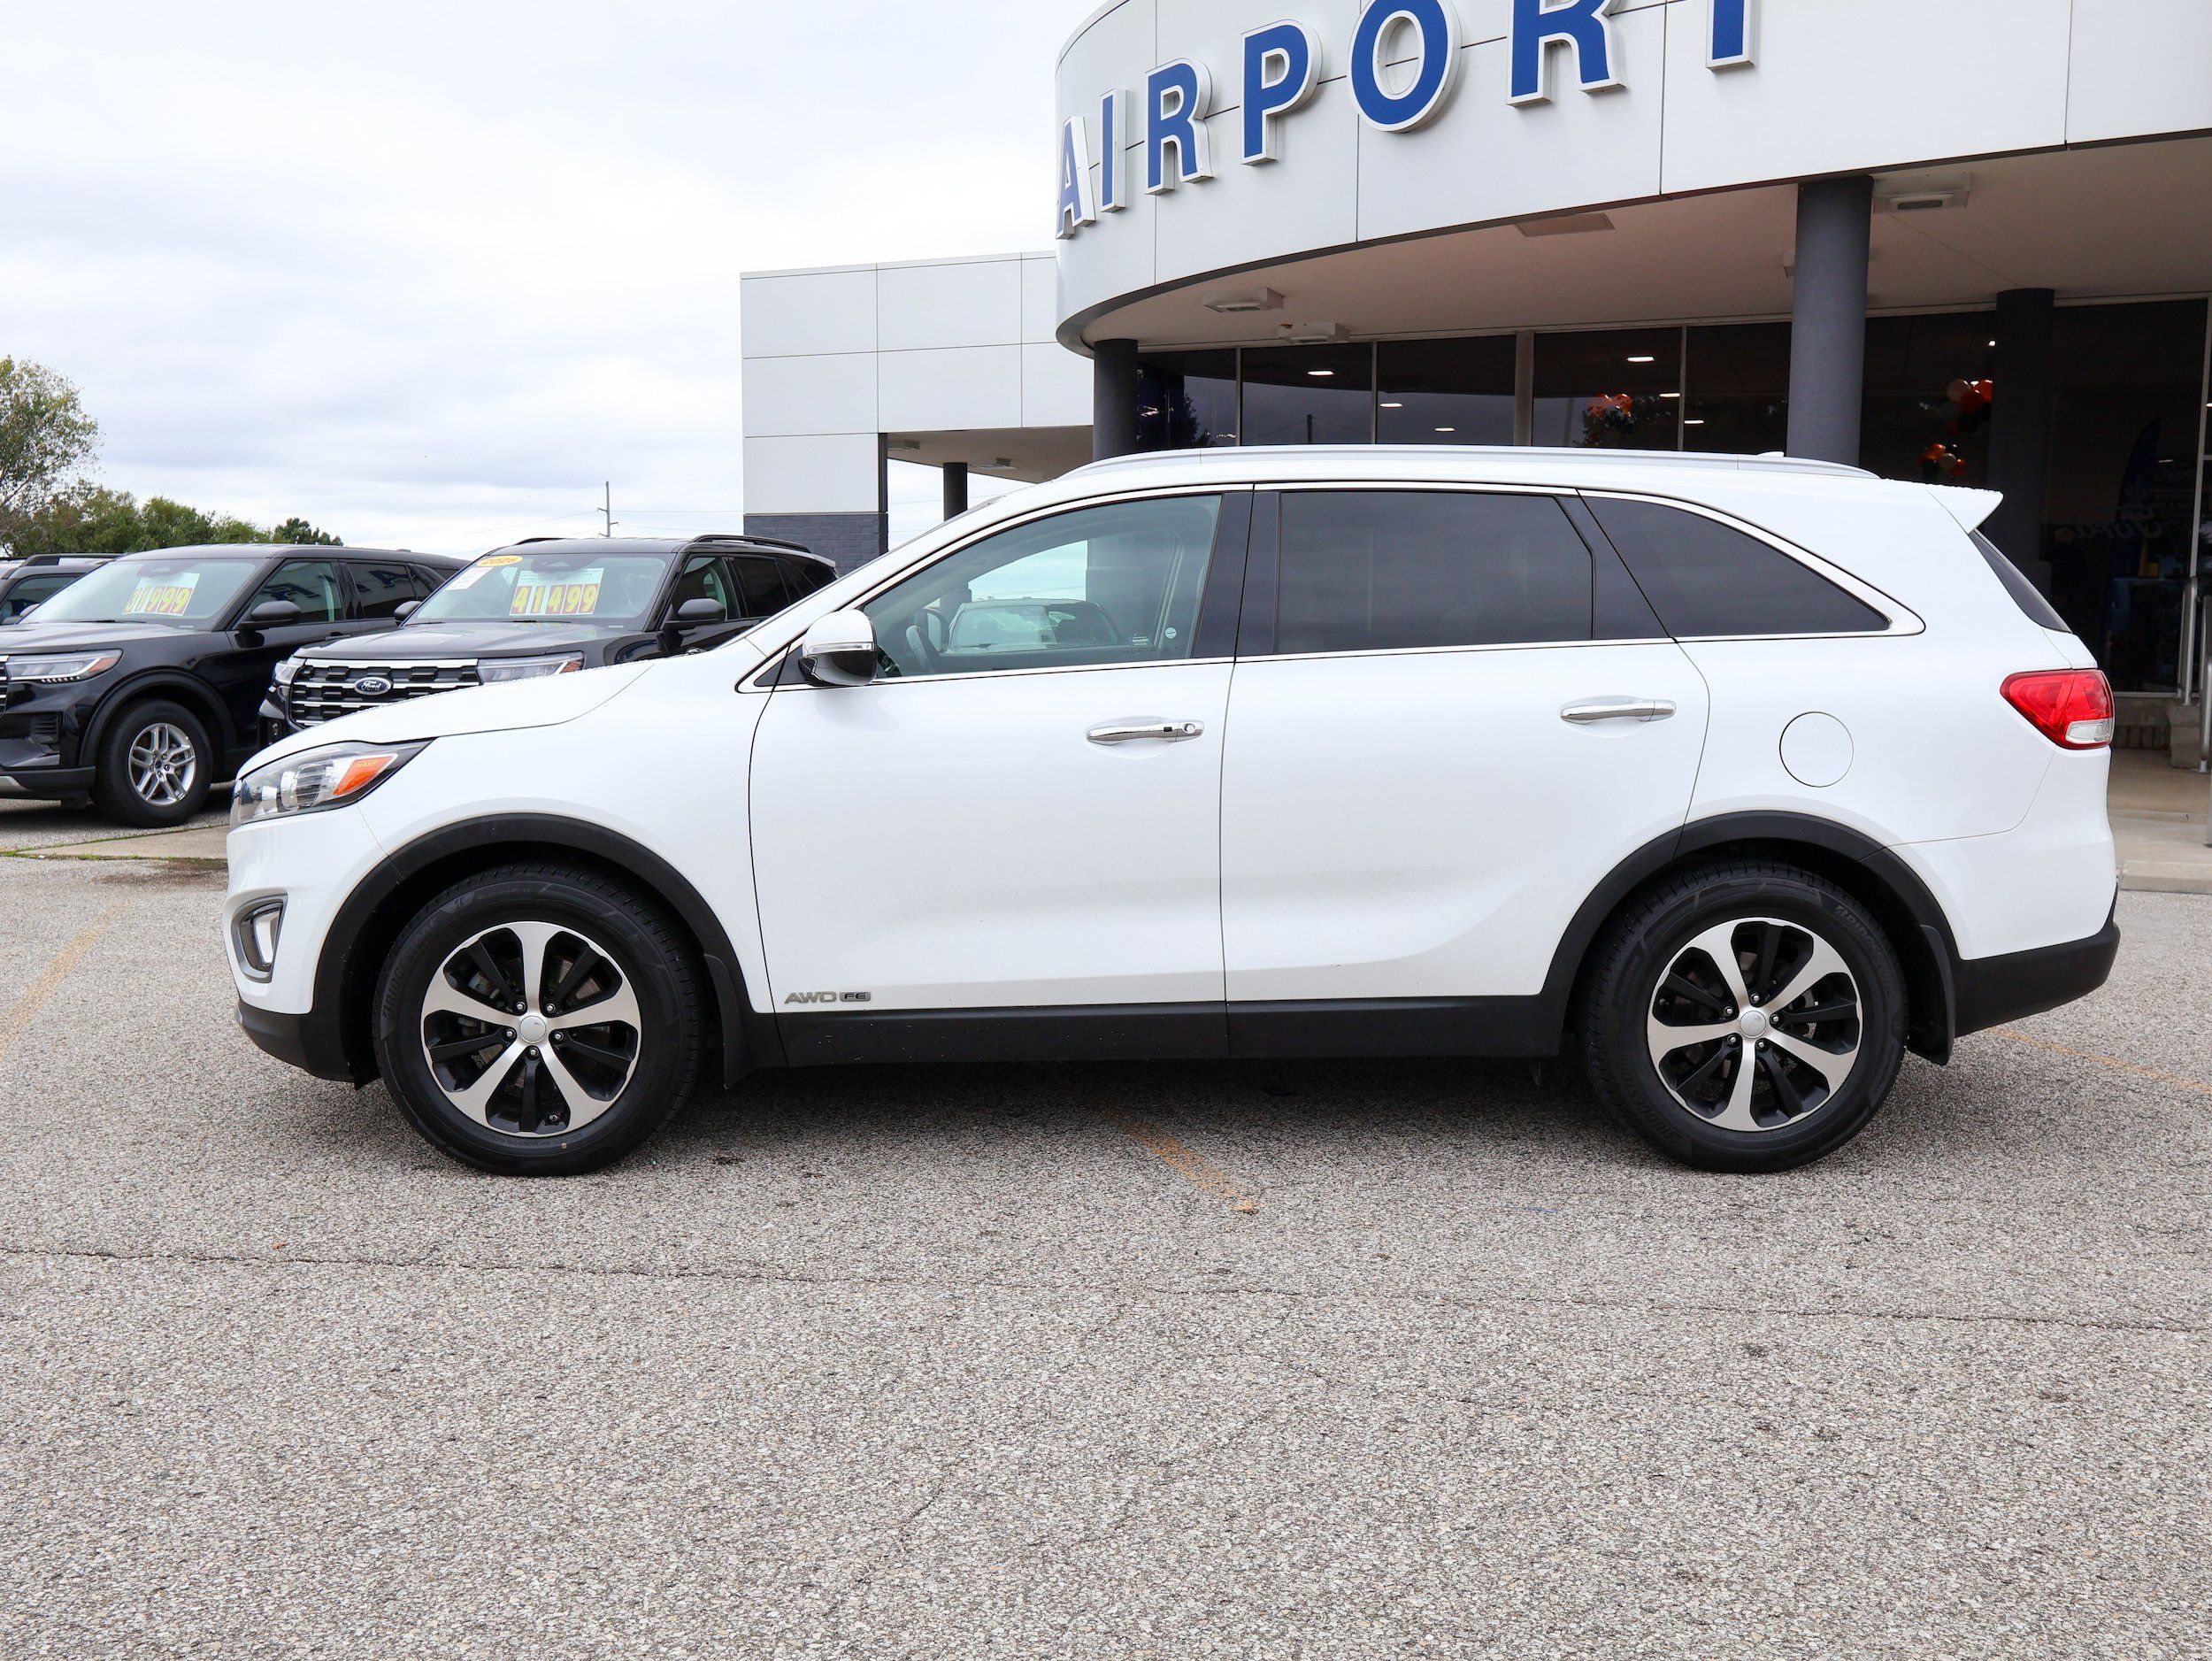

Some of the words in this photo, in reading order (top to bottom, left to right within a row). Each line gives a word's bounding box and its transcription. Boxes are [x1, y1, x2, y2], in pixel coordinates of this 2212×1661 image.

[513, 586, 596, 612] 41499
[361, 681, 382, 690] Ford
[784, 991, 837, 1004] AWD
